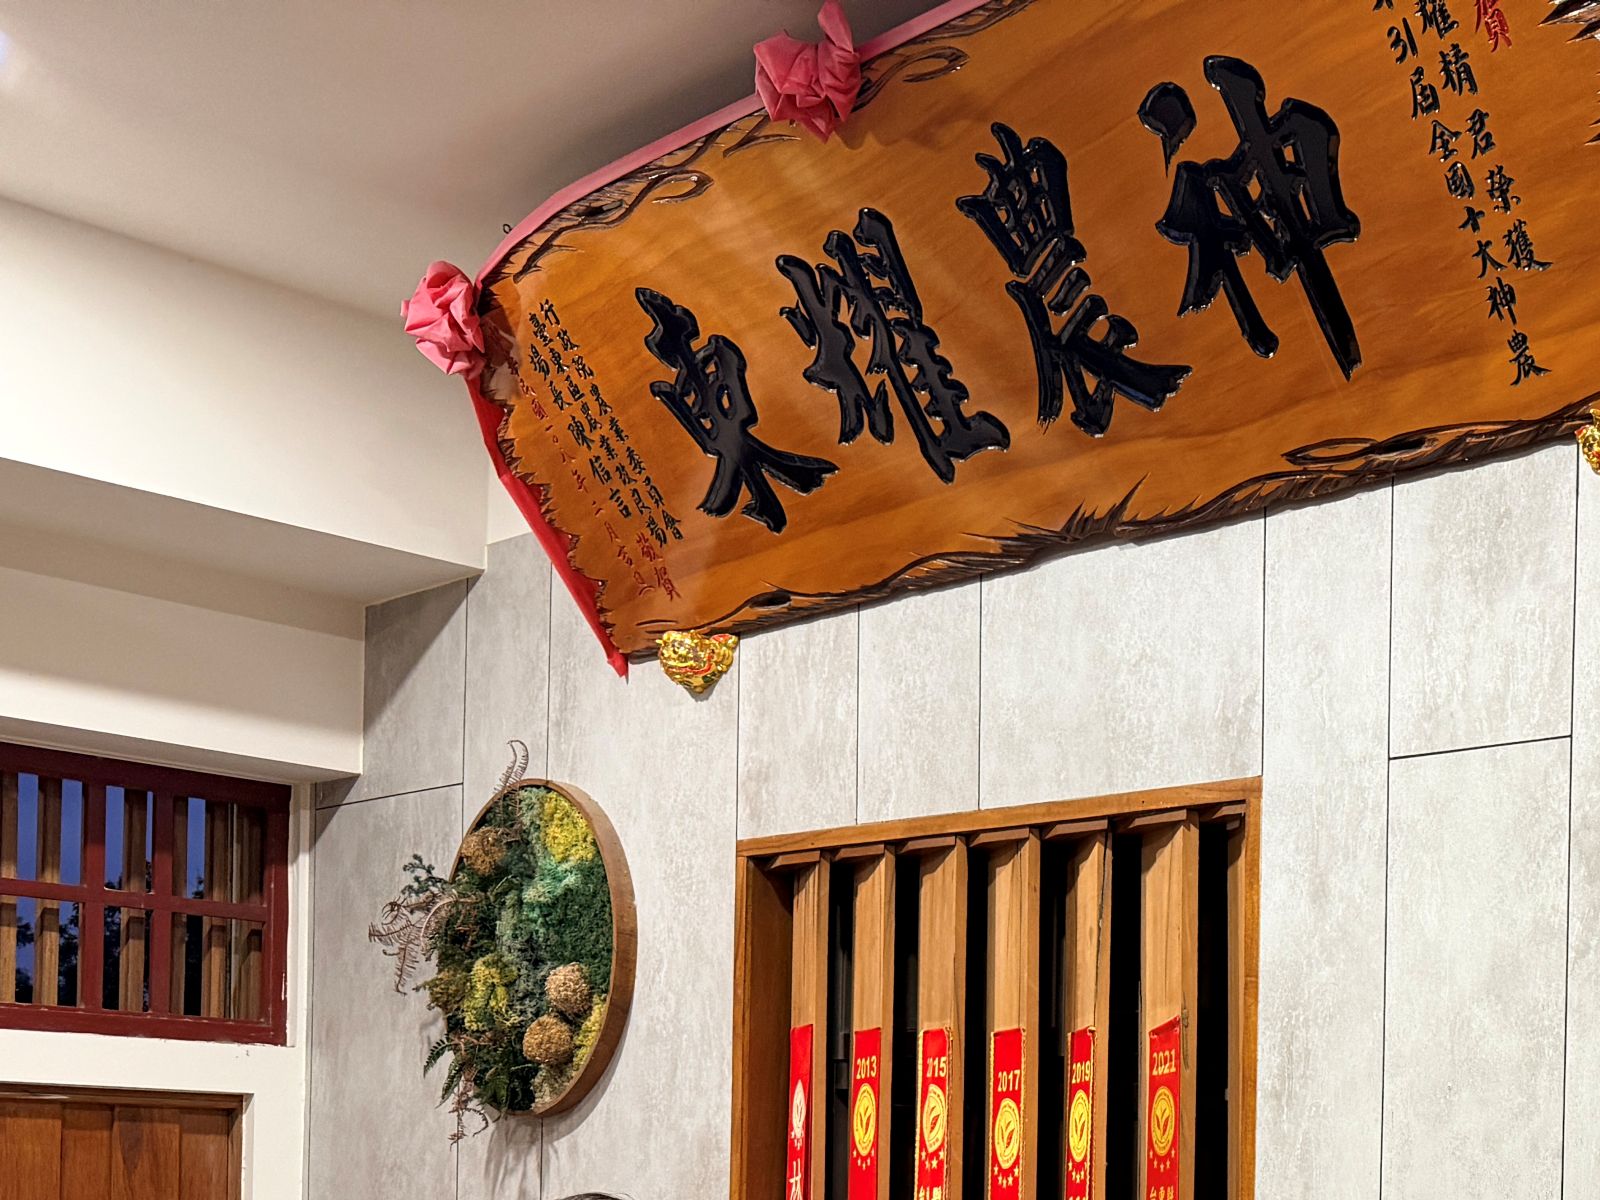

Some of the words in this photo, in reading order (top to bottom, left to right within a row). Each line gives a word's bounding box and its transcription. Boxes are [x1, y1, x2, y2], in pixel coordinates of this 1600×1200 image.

[856, 1055, 877, 1080] 2013
[1071, 1060, 1091, 1084] 2019
[1152, 1048, 1177, 1076] 2021
[997, 1069, 1021, 1093] 2017
